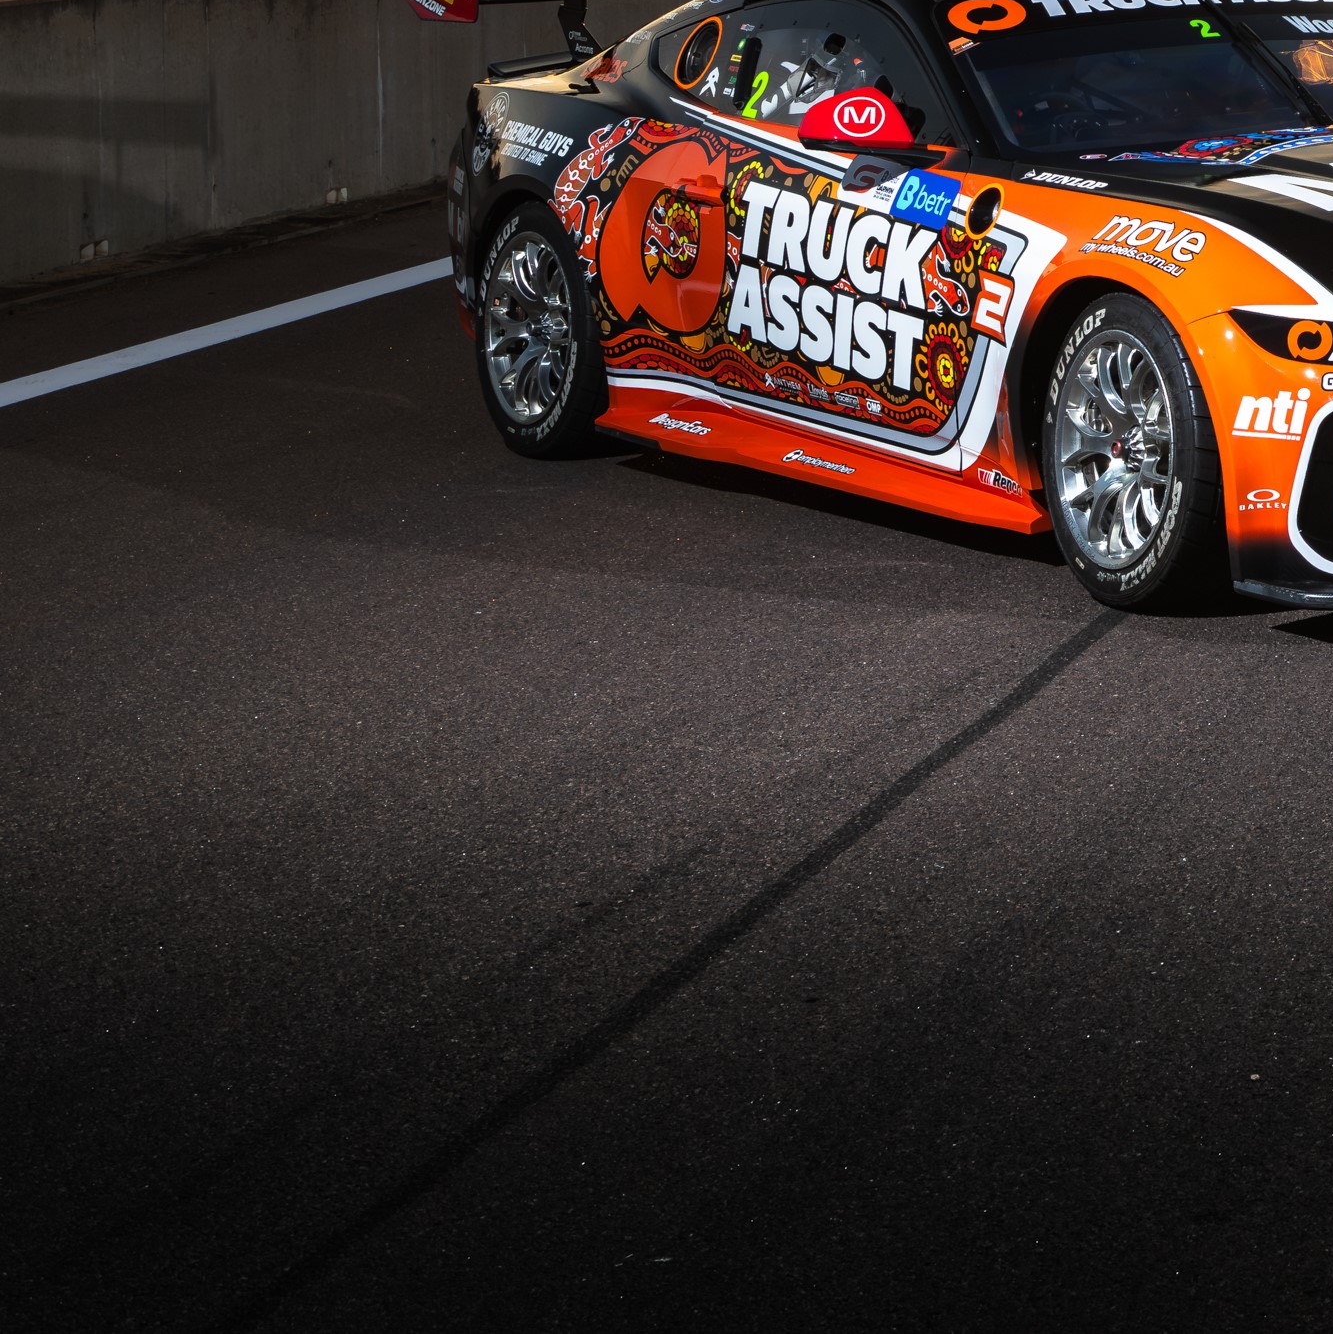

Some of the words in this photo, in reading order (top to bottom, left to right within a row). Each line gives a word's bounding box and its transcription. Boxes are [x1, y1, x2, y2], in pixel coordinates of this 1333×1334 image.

[1189, 19, 1221, 38] 2
[742, 71, 769, 119] 2
[843, 106, 877, 125] M
[501, 120, 543, 148] CHEMICAL
[538, 131, 574, 157] GUYS
[915, 184, 951, 216] betr
[1034, 172, 1108, 189] DUNLOP
[480, 216, 520, 299] DUNLOP
[740, 181, 938, 309] TRUCK
[1091, 215, 1207, 262] move
[975, 277, 1012, 331] 2
[727, 264, 924, 391] ASSIST
[1050, 308, 1106, 405] DUNLOP
[773, 377, 802, 391] ANTHEM
[866, 401, 882, 413] OMP
[1233, 387, 1311, 435] nti
[1239, 503, 1287, 511] OAKLEY
